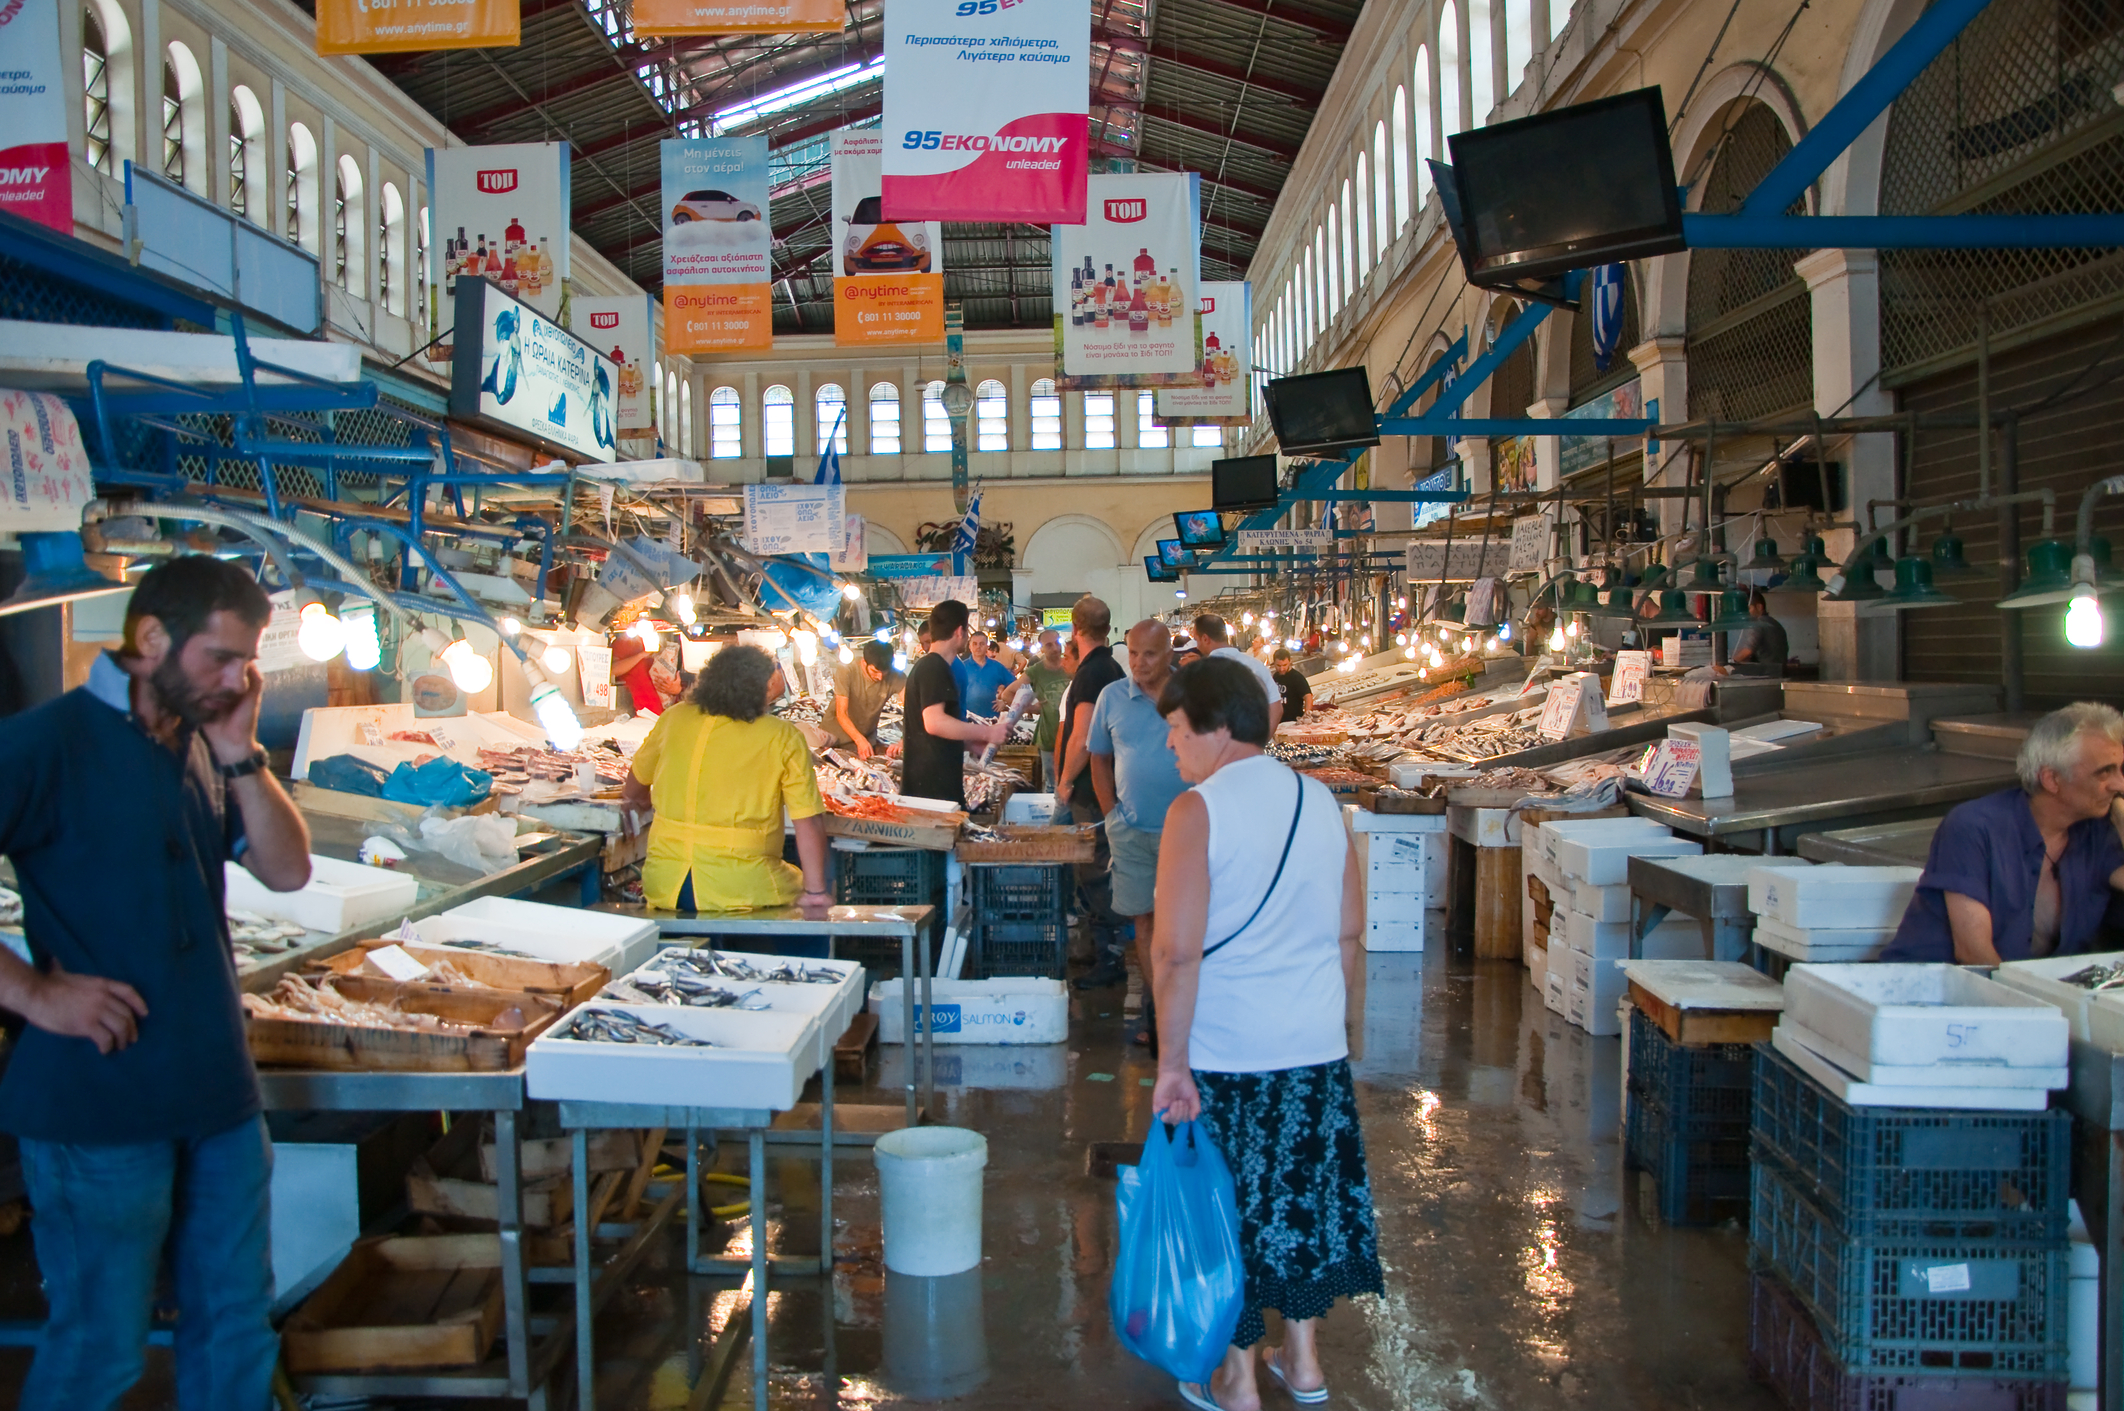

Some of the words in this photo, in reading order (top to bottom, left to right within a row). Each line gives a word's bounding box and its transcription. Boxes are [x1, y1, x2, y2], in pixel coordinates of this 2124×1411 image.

[694, 4, 791, 18] www.anytime.gr
[375, 21, 468, 36] www.anytime.gr
[905, 34, 985, 48] Περισσότερα
[989, 36, 1059, 50] χιλιόμετρα,
[1019, 52, 1071, 64] καύσιμο
[844, 138, 879, 147] Ασφάλιση
[902, 130, 1068, 153] 95EKONOMY
[684, 148, 702, 159] Μη
[704, 147, 742, 160] μένεις
[844, 148, 866, 156] ακόμα
[684, 164, 710, 174] στον
[713, 162, 745, 175] αέρα!
[1006, 158, 1061, 170] unleaded
[480, 172, 514, 190] ΤΟΠ
[1107, 202, 1142, 220] ΤΟΠ
[670, 253, 719, 265] Χρειάζεσαι
[721, 252, 764, 263] αξιόπιστη
[666, 265, 709, 277] ασφάλιση
[711, 263, 766, 275] αυτοκινήτου
[844, 285, 909, 300] @nytime
[674, 293, 738, 309] @nytime
[592, 313, 617, 328] ΤΟΠ
[864, 313, 879, 322] 801
[882, 312, 892, 321] 11
[894, 311, 921, 321] 30000
[693, 322, 708, 331] 801
[711, 322, 721, 331] 11
[723, 321, 750, 330] 30000
[866, 328, 918, 336] www.anytime.gr
[1083, 343, 1112, 351] Νόστιμο
[1149, 342, 1175, 350] φαγητό
[1085, 351, 1102, 359] είναι
[1103, 351, 1129, 359] μονάχα
[524, 335, 530, 355] Η
[532, 341, 556, 369] ΩΡΑΙΑ
[557, 354, 591, 389] ΚΑΤΕΡΙΝΑ
[1246, 530, 1299, 539] ΚΑΤΕΨΥΓΜΕΝΑ
[1304, 530, 1326, 538] ΨΑΡΙΑ
[1259, 538, 1290, 546] ΚΛΩΝΗΣ
[962, 1013, 1012, 1026] SALMON
